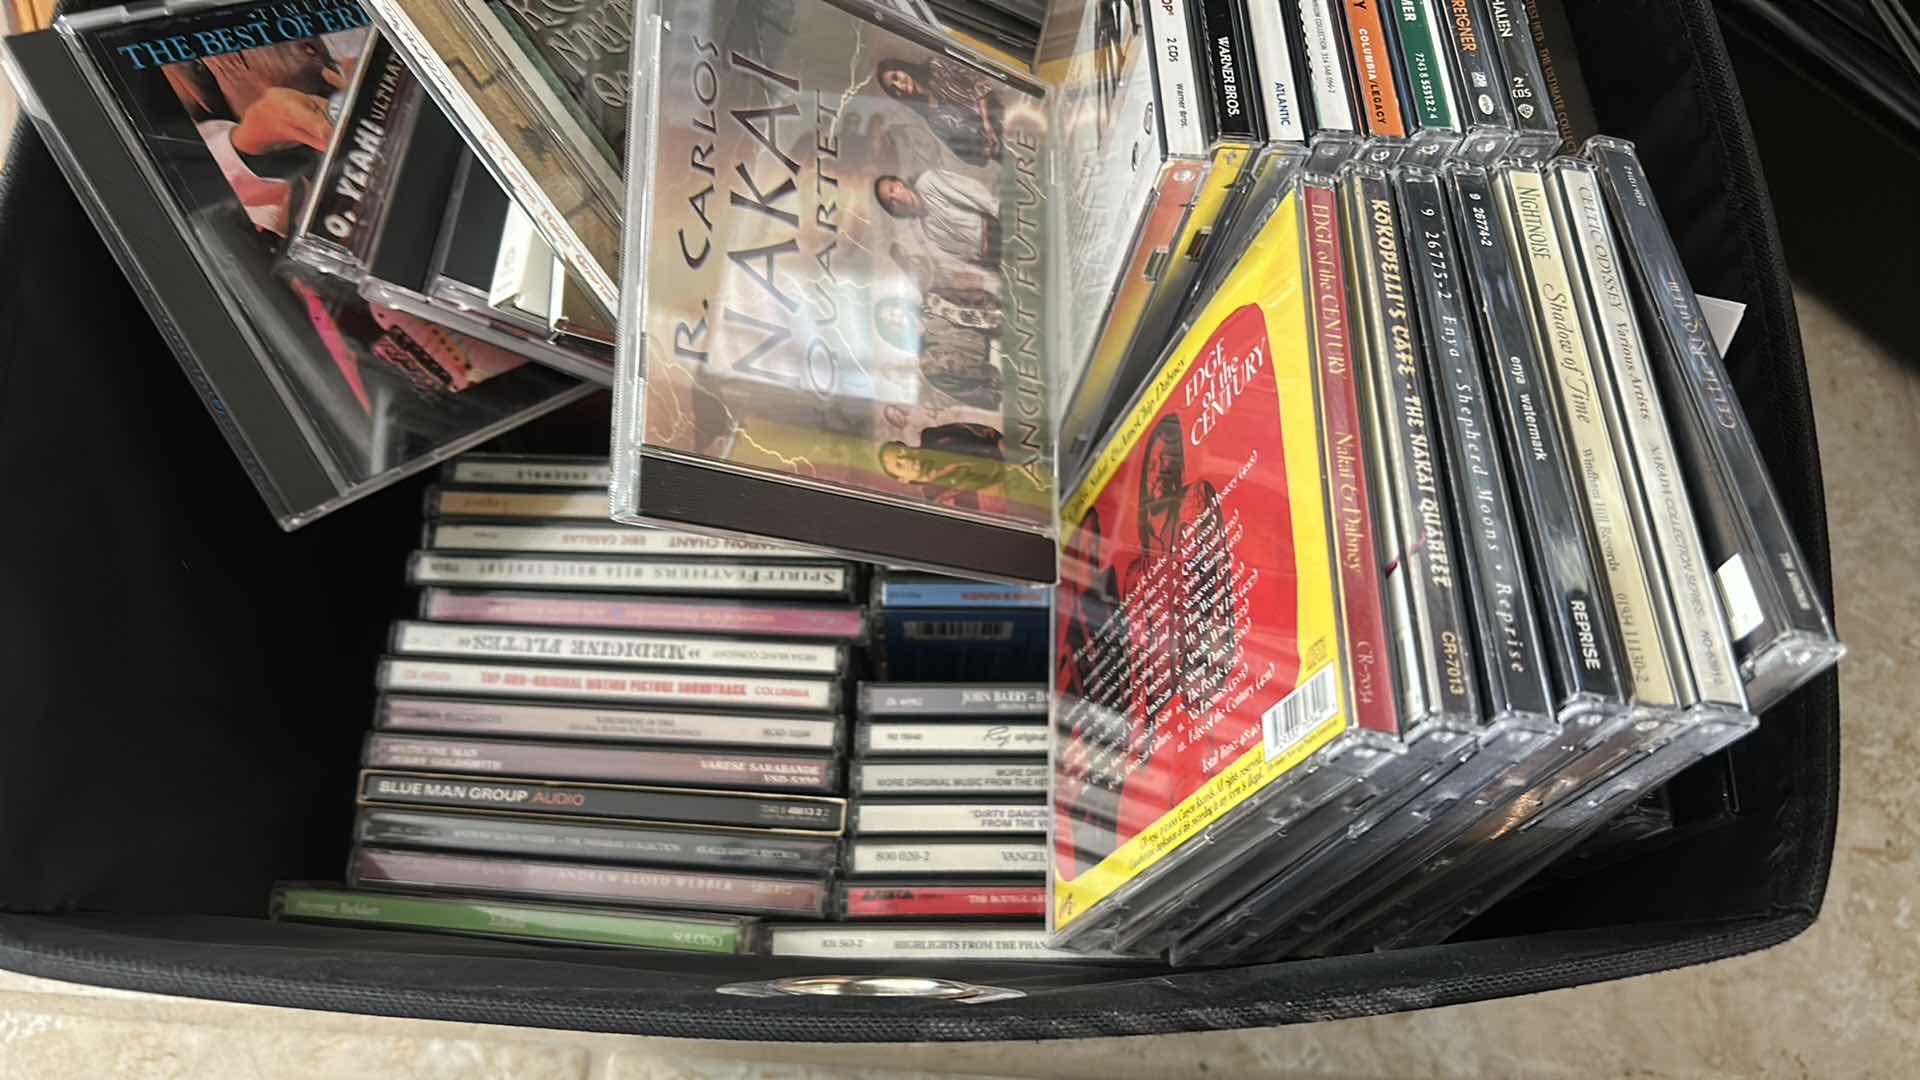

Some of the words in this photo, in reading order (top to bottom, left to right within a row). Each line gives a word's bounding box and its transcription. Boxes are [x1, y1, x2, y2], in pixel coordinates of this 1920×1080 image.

[117, 35, 197, 70] THE
[192, 20, 273, 57] BEST
[275, 13, 317, 41] OF
[1216, 36, 1235, 84] WARNER
[1175, 82, 1185, 107] Warner
[1221, 83, 1241, 118] BROS.
[1358, 28, 1387, 125] COLUMBIA/LEGACY
[1513, 77, 1525, 88] 2
[1177, 107, 1188, 128] Bros.
[1274, 82, 1292, 127] ATLANTIC
[336, 118, 386, 202] YEAH!
[677, 34, 721, 272] CARLOS
[723, 51, 802, 383] NAKAI
[1016, 133, 1041, 290] FUTURE
[1420, 207, 1435, 217] 9
[1469, 193, 1481, 202] 9
[803, 89, 842, 398] QUARTET
[1311, 203, 1332, 249] EDGE
[1471, 206, 1494, 248] 26774-2
[1371, 198, 1407, 320] KOKOPELLI'S
[1424, 231, 1453, 299] 26775-2
[673, 299, 710, 364] R.
[1320, 295, 1349, 380] CENTURY
[1440, 314, 1461, 358] Enya
[1541, 281, 1575, 356] Shadow
[1185, 337, 1225, 407] EDGE
[1202, 384, 1216, 410] of
[1219, 355, 1240, 386] the
[1557, 352, 1581, 375] of
[1577, 185, 1601, 237] CELTIC
[1594, 238, 1625, 313] ODYSSEY
[1615, 320, 1636, 374] Various
[1628, 369, 1650, 421] Artists
[1665, 498, 1693, 576] COLLECTION
[1014, 302, 1042, 486] ANCIENT
[1190, 337, 1266, 446] CENTURY
[1402, 393, 1424, 432] THE
[1563, 370, 1592, 425] Time
[1335, 431, 1355, 480] Nakai
[1455, 382, 1489, 477] Shepherd
[1410, 432, 1435, 491] NAKAI
[1581, 447, 1602, 501] Windham
[1476, 484, 1501, 552] Moons
[1509, 355, 1527, 385] enya
[1518, 393, 1547, 462] watermark
[1570, 599, 1601, 671] REPRISE
[1590, 499, 1608, 522] Hill
[1342, 503, 1367, 576] Dabney
[1417, 496, 1452, 588] QUARTET
[1599, 518, 1621, 573] Records
[653, 566, 760, 585] FEATHERS
[767, 569, 838, 586] SPIRIT
[1495, 582, 1525, 673] Reprise
[1441, 631, 1465, 695] CR-7013
[754, 685, 810, 697] COLUMBIA
[961, 690, 991, 704] JOHN
[378, 780, 423, 796] BLUE
[423, 781, 468, 799] MAN
[468, 786, 530, 803] GROUP
[532, 790, 586, 807] AUDIO
[953, 777, 983, 787] MUSIC
[984, 777, 1012, 787] FROM
[1013, 777, 1033, 787] THE
[981, 818, 1012, 828] FROM
[893, 939, 961, 951] HIGHLIGHTS
[962, 940, 994, 950] FROM
[995, 940, 1018, 950] THE
